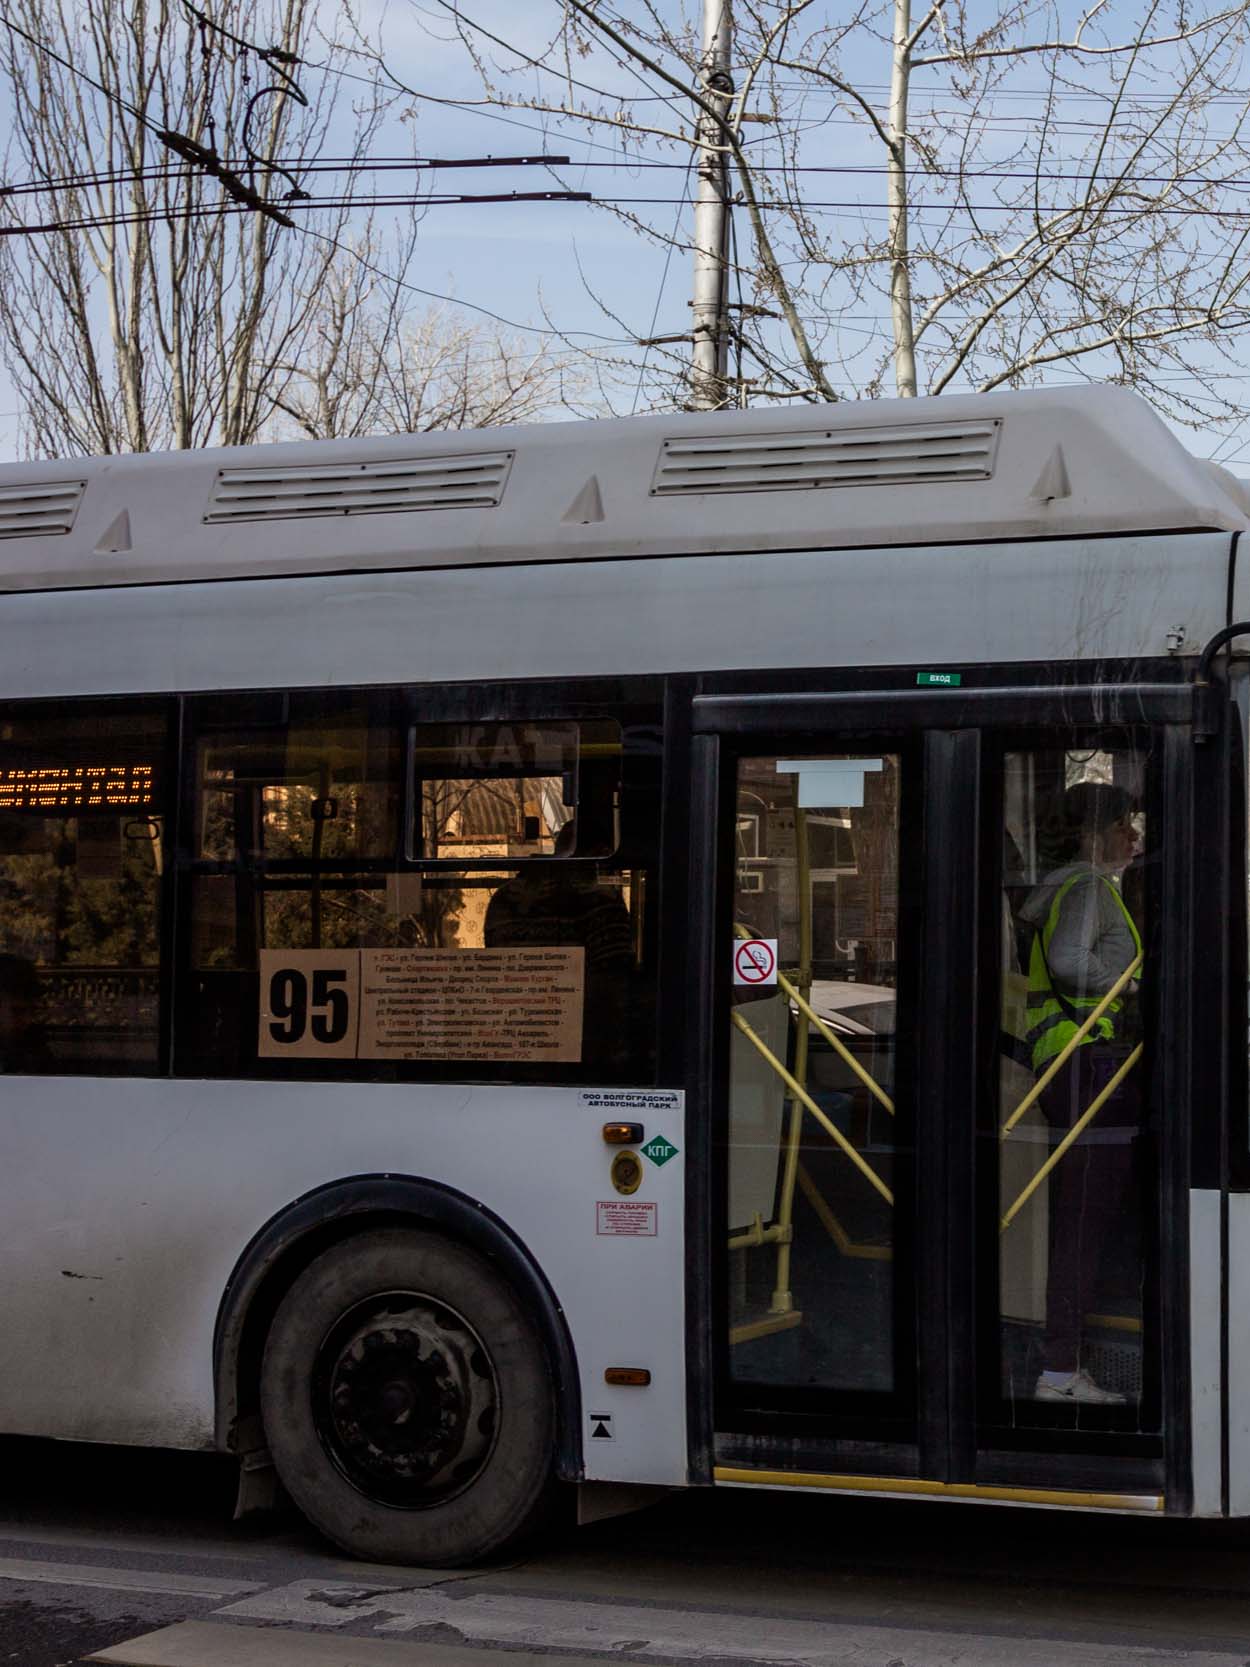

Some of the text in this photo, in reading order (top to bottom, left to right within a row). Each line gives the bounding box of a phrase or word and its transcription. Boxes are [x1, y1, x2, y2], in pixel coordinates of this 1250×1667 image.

[269, 969, 349, 1044] 95
[603, 1094, 679, 1102] ВОЛГОГРАДСКИЙ
[588, 1100, 646, 1108] АВТОБУСНЫЙ
[648, 1145, 673, 1157] КПГ
